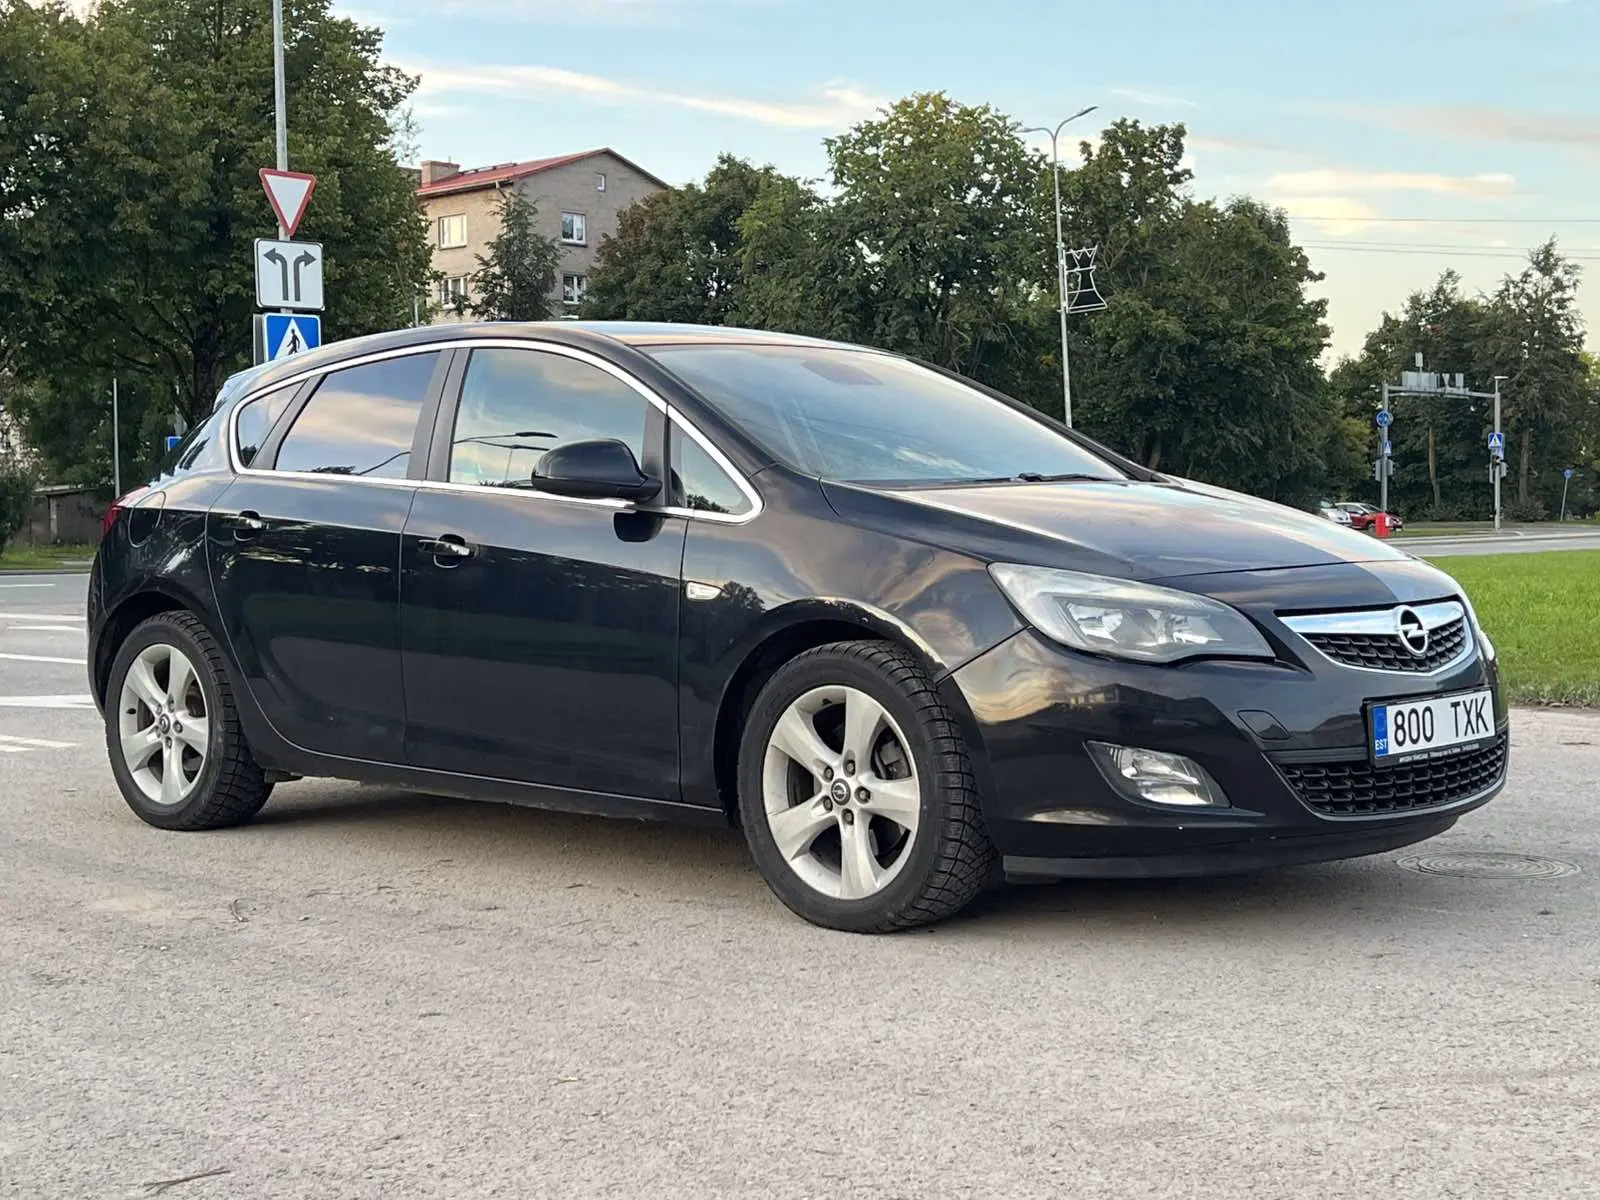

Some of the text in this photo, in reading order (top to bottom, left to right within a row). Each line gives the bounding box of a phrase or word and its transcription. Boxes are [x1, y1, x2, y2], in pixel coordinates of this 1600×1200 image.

[1394, 696, 1489, 747] 800 TXK
[1374, 738, 1388, 750] EST
